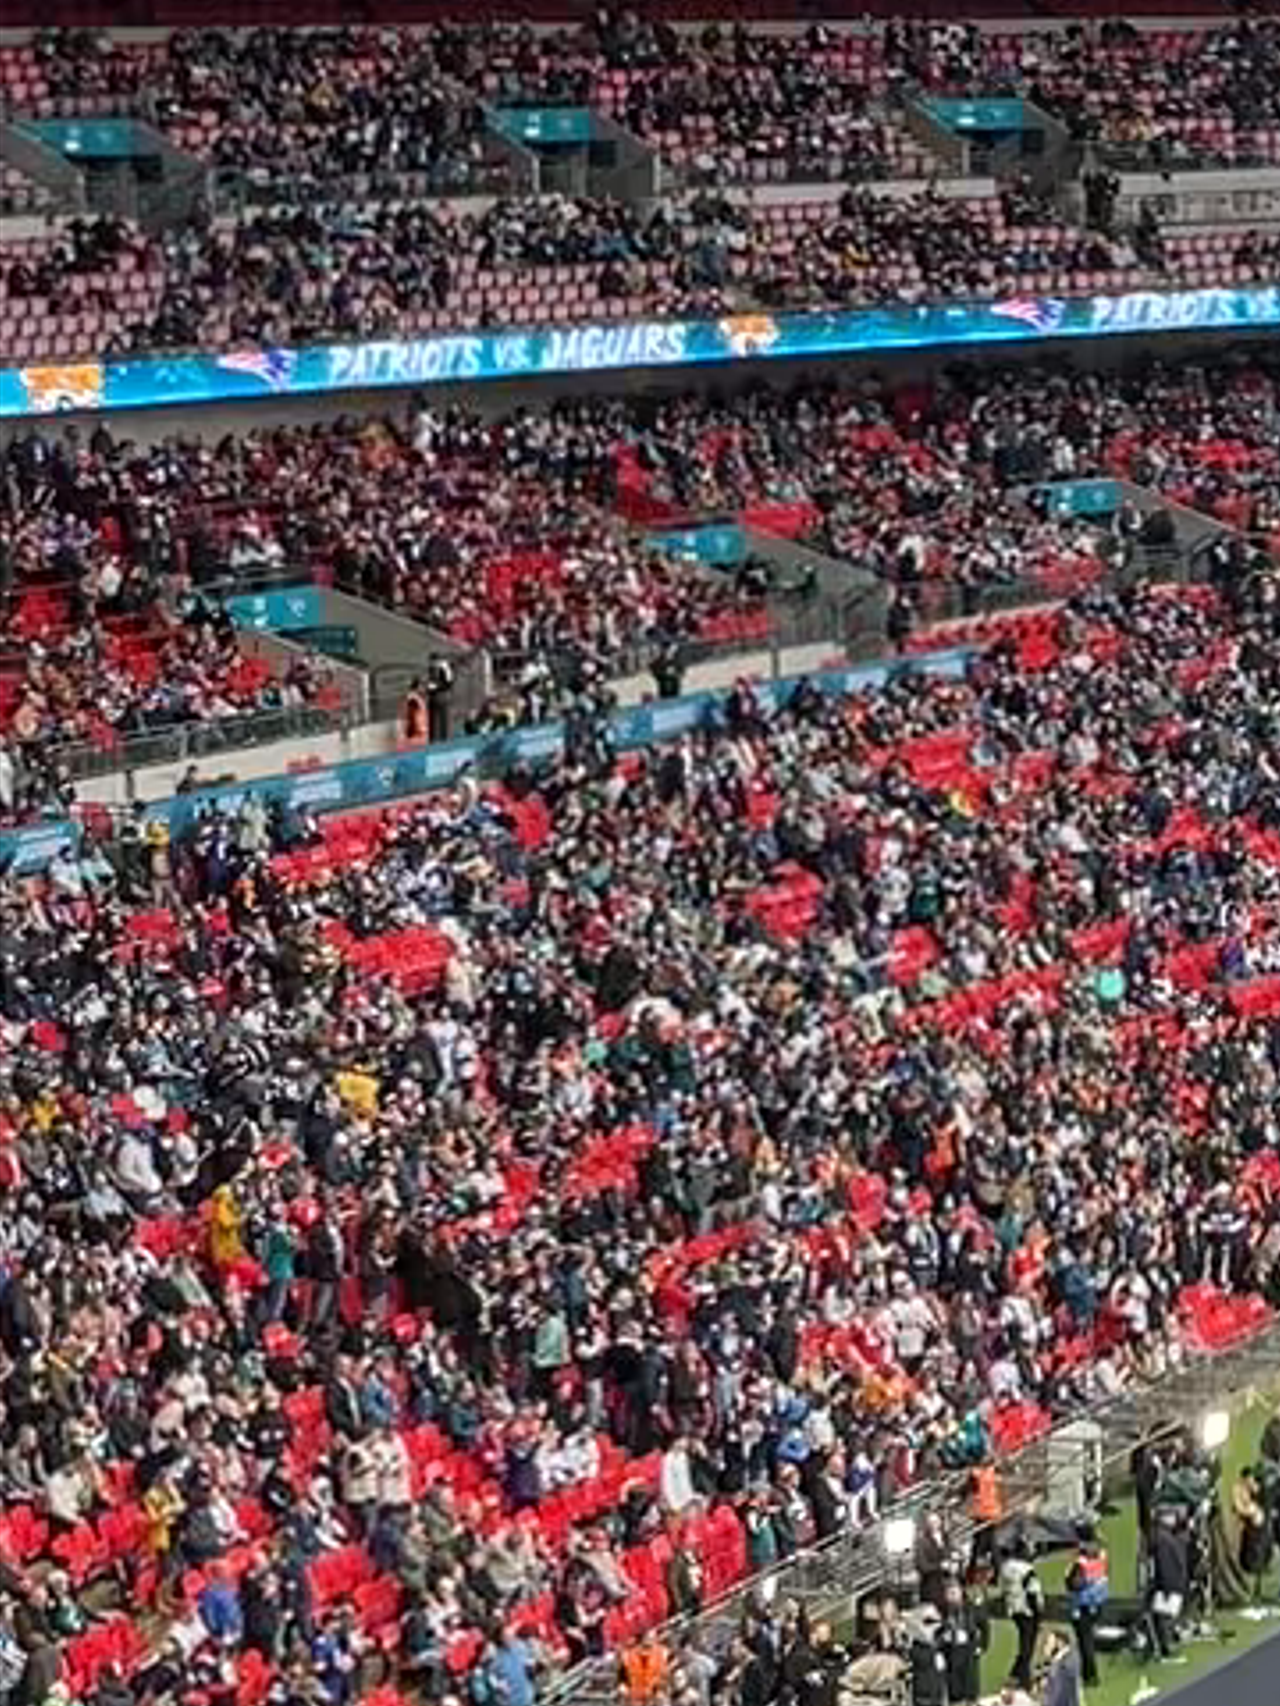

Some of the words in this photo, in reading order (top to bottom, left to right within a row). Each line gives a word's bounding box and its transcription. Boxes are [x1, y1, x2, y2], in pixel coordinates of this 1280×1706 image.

[1091, 289, 1237, 330] PATRIOTS
[328, 339, 483, 386] PATRIOTS
[541, 323, 686, 371] JAGUARS
